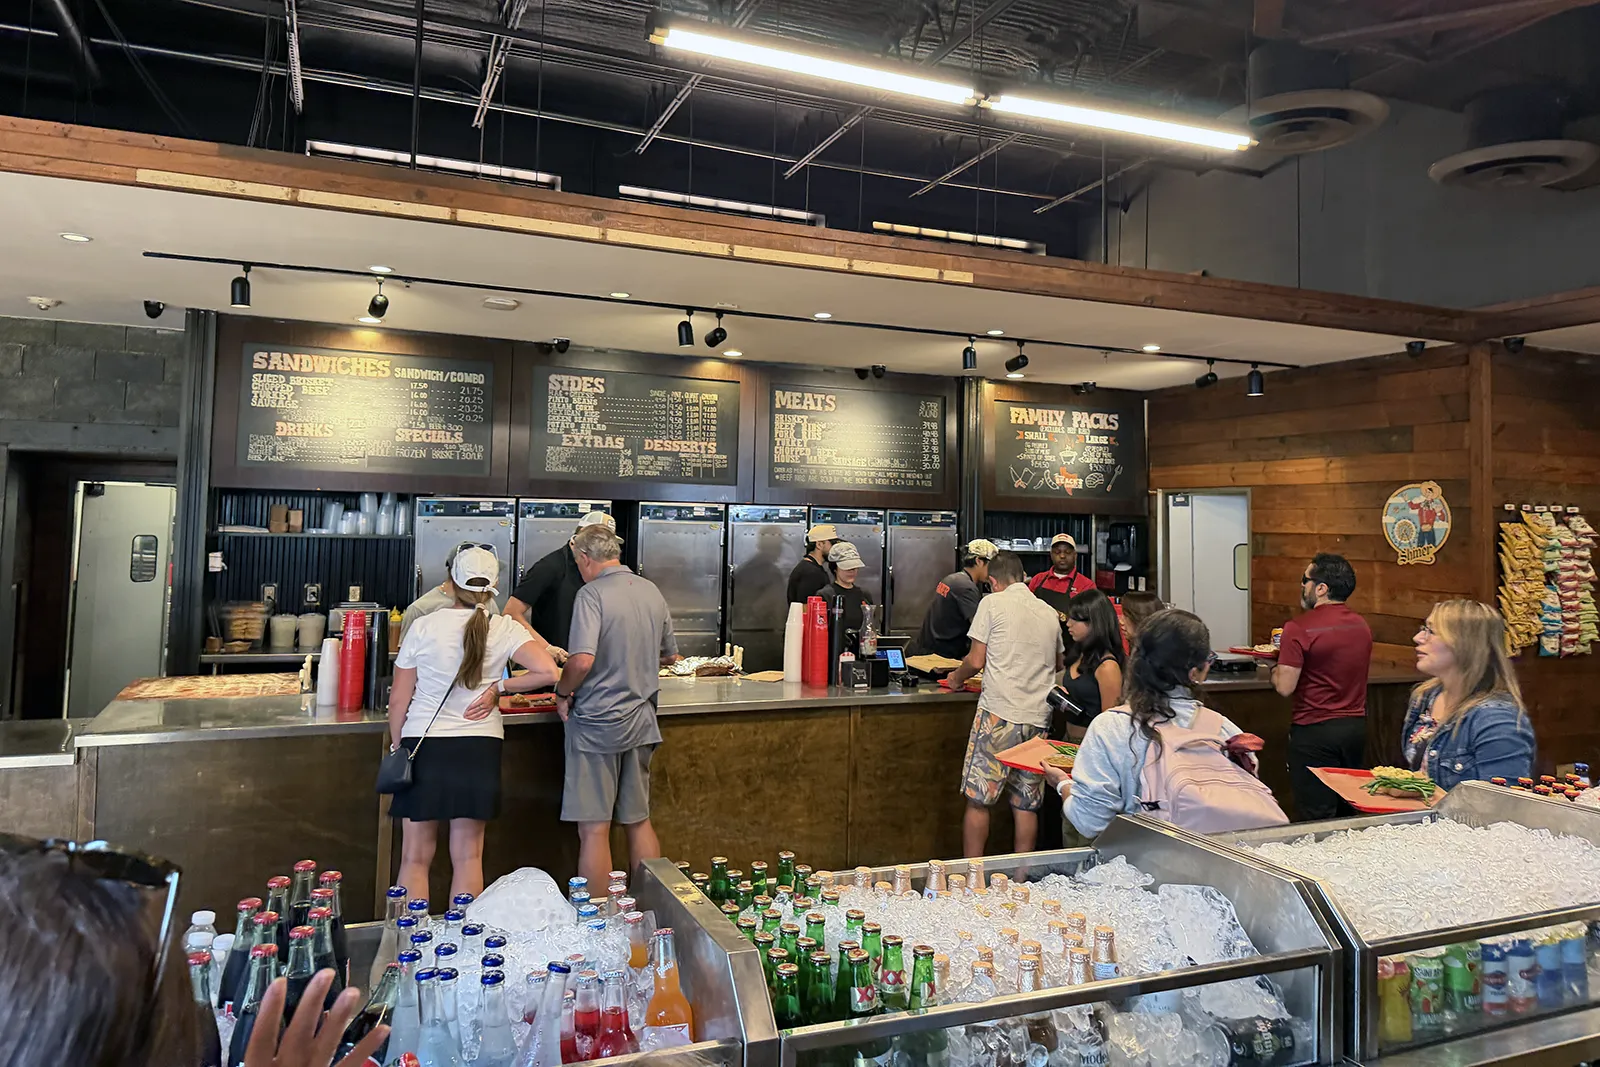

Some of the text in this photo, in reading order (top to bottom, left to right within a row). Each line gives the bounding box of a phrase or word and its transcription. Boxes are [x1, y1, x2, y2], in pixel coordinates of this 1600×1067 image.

[252, 351, 485, 385] SANDWICHES SANDWICH/COMBO
[252, 373, 286, 384] SLICED
[289, 376, 333, 386] BRISKET
[460, 386, 484, 396] 21.75
[548, 374, 605, 394] SIDES
[251, 383, 294, 392] CHOPPED
[301, 385, 330, 395] BEEF
[459, 395, 484, 404] 20.25
[572, 397, 598, 405] BEANS
[774, 390, 836, 412] MEATS
[251, 391, 295, 400] TURKEY
[458, 404, 484, 413] 20.25
[548, 402, 572, 410] CREAM
[250, 398, 299, 408] SAUSAGE
[458, 413, 484, 422] 20.25
[774, 413, 809, 423] BRISKET
[1009, 406, 1120, 431] FAMILY PACKS
[275, 421, 464, 443] DRINKS SPECIALS
[580, 423, 607, 431] SALAD
[774, 422, 795, 430] BEEF
[801, 421, 822, 432] RIBS
[774, 430, 795, 439] PORK
[801, 430, 822, 440] RIBS
[774, 438, 808, 447] TURKEY
[1024, 431, 1048, 440] SMALL
[561, 434, 717, 453] EXTRAS DESSERTS
[395, 448, 427, 459] FROZEN
[774, 446, 811, 456] CHOPPED
[816, 448, 837, 457] BEEF
[774, 454, 800, 463] HOUSE
[806, 455, 827, 464] MADE
[832, 457, 867, 467] SAUSAGE
[1399, 545, 1433, 563] Shiner
